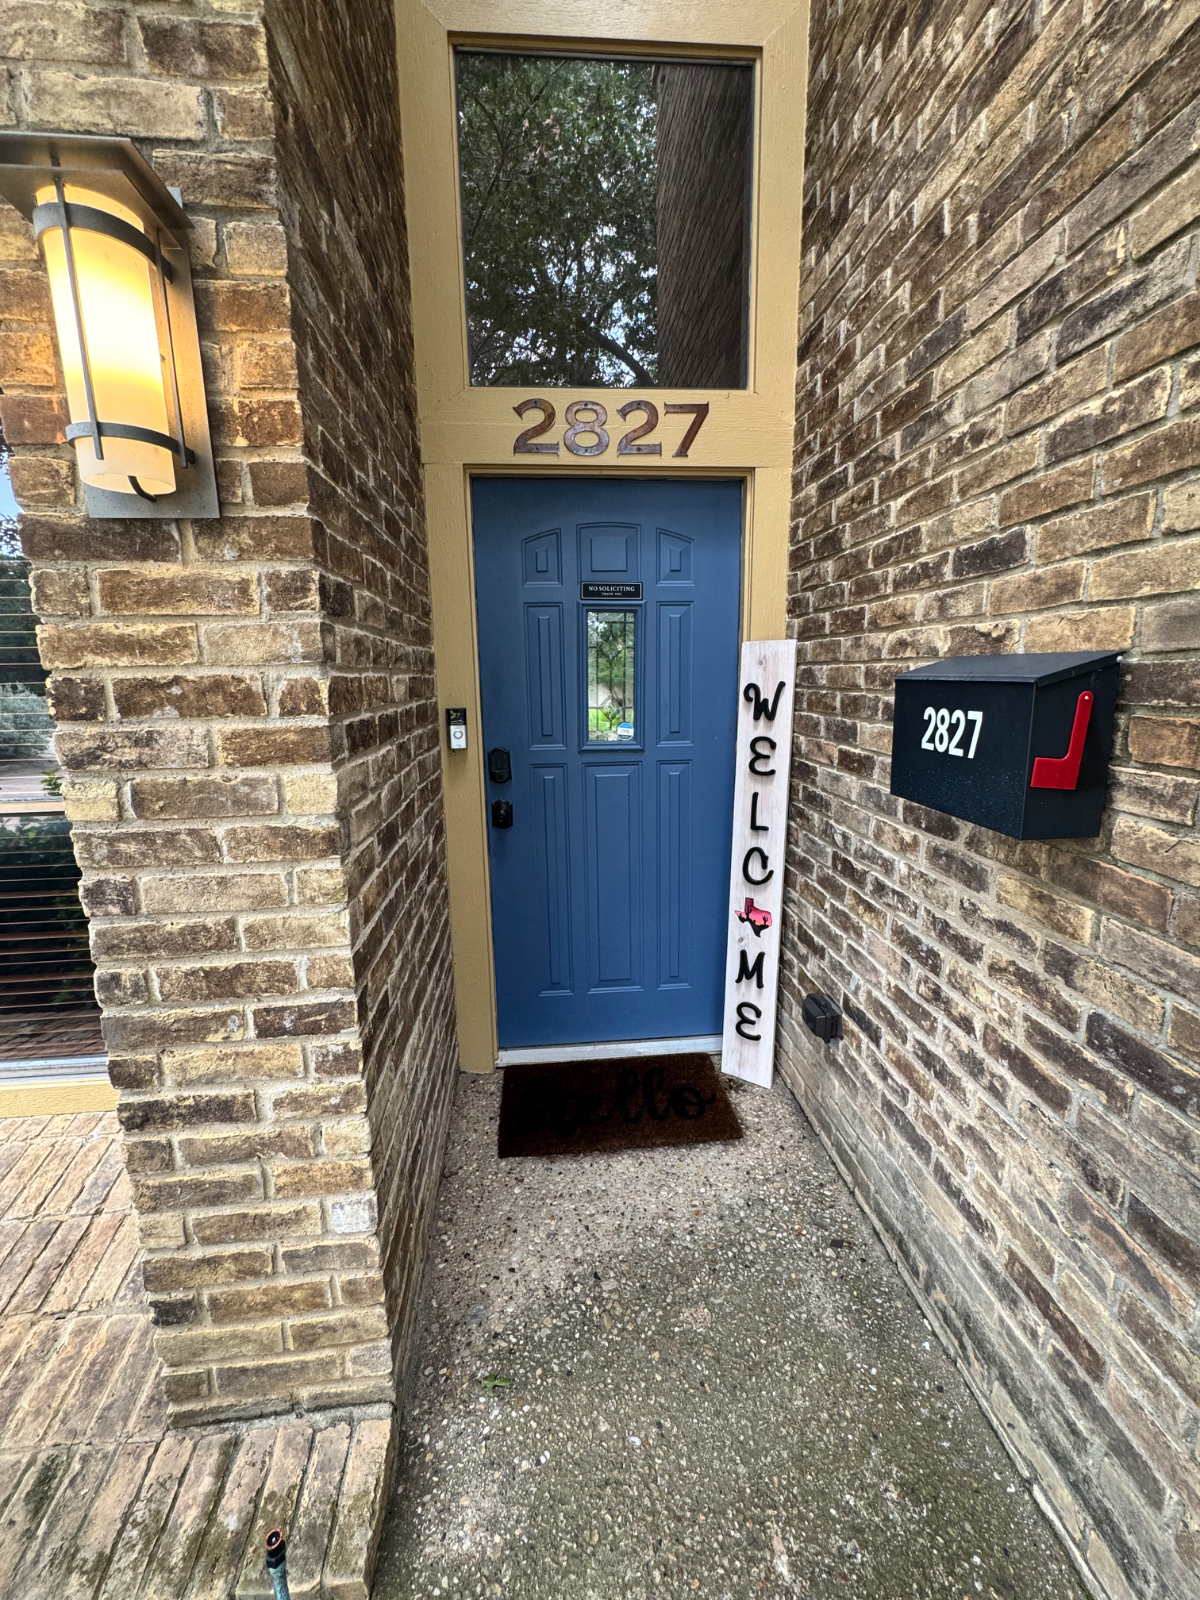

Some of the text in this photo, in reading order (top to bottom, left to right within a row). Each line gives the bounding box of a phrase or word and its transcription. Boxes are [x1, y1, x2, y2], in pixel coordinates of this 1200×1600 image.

[513, 398, 710, 458] 2827
[921, 706, 983, 759] 2827
[735, 680, 786, 1041] WELCME
